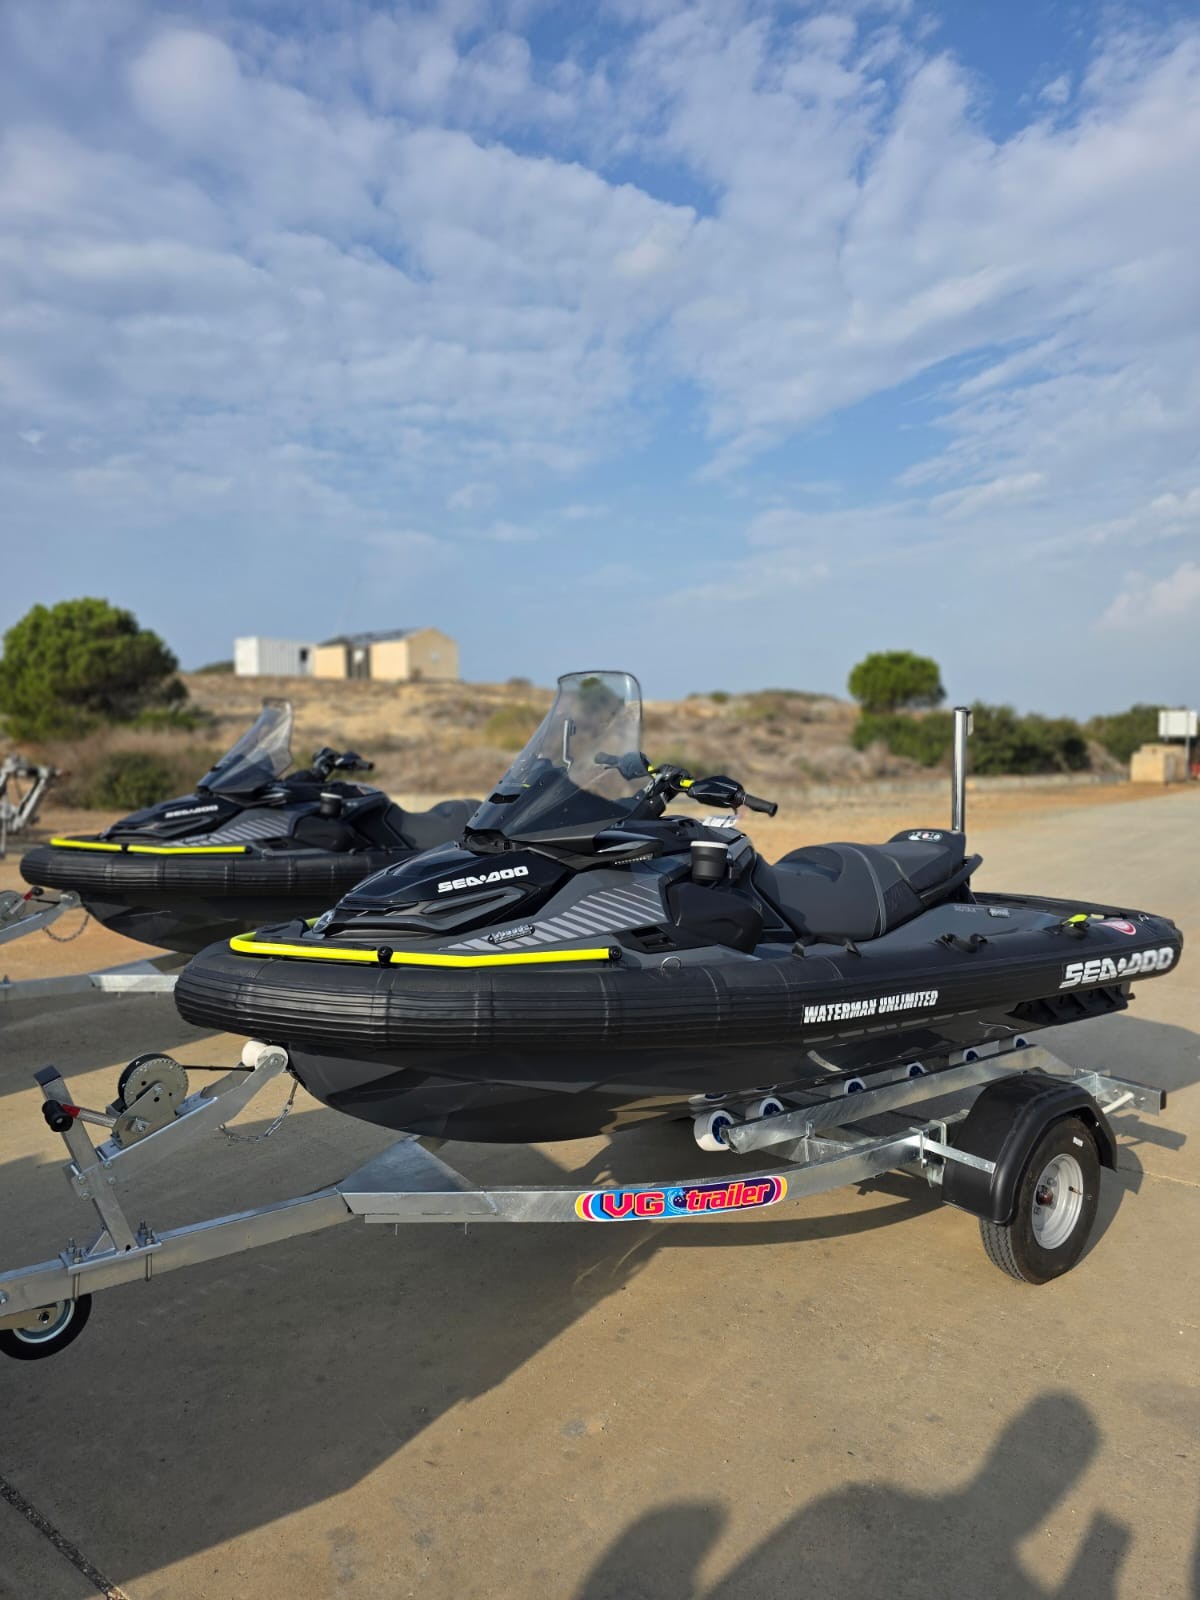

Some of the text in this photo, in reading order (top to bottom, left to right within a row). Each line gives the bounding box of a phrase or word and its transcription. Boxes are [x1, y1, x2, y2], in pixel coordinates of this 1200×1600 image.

[803, 990, 938, 1024] WATERMAN UNLIMITED
[602, 1182, 771, 1218] VG trailer
